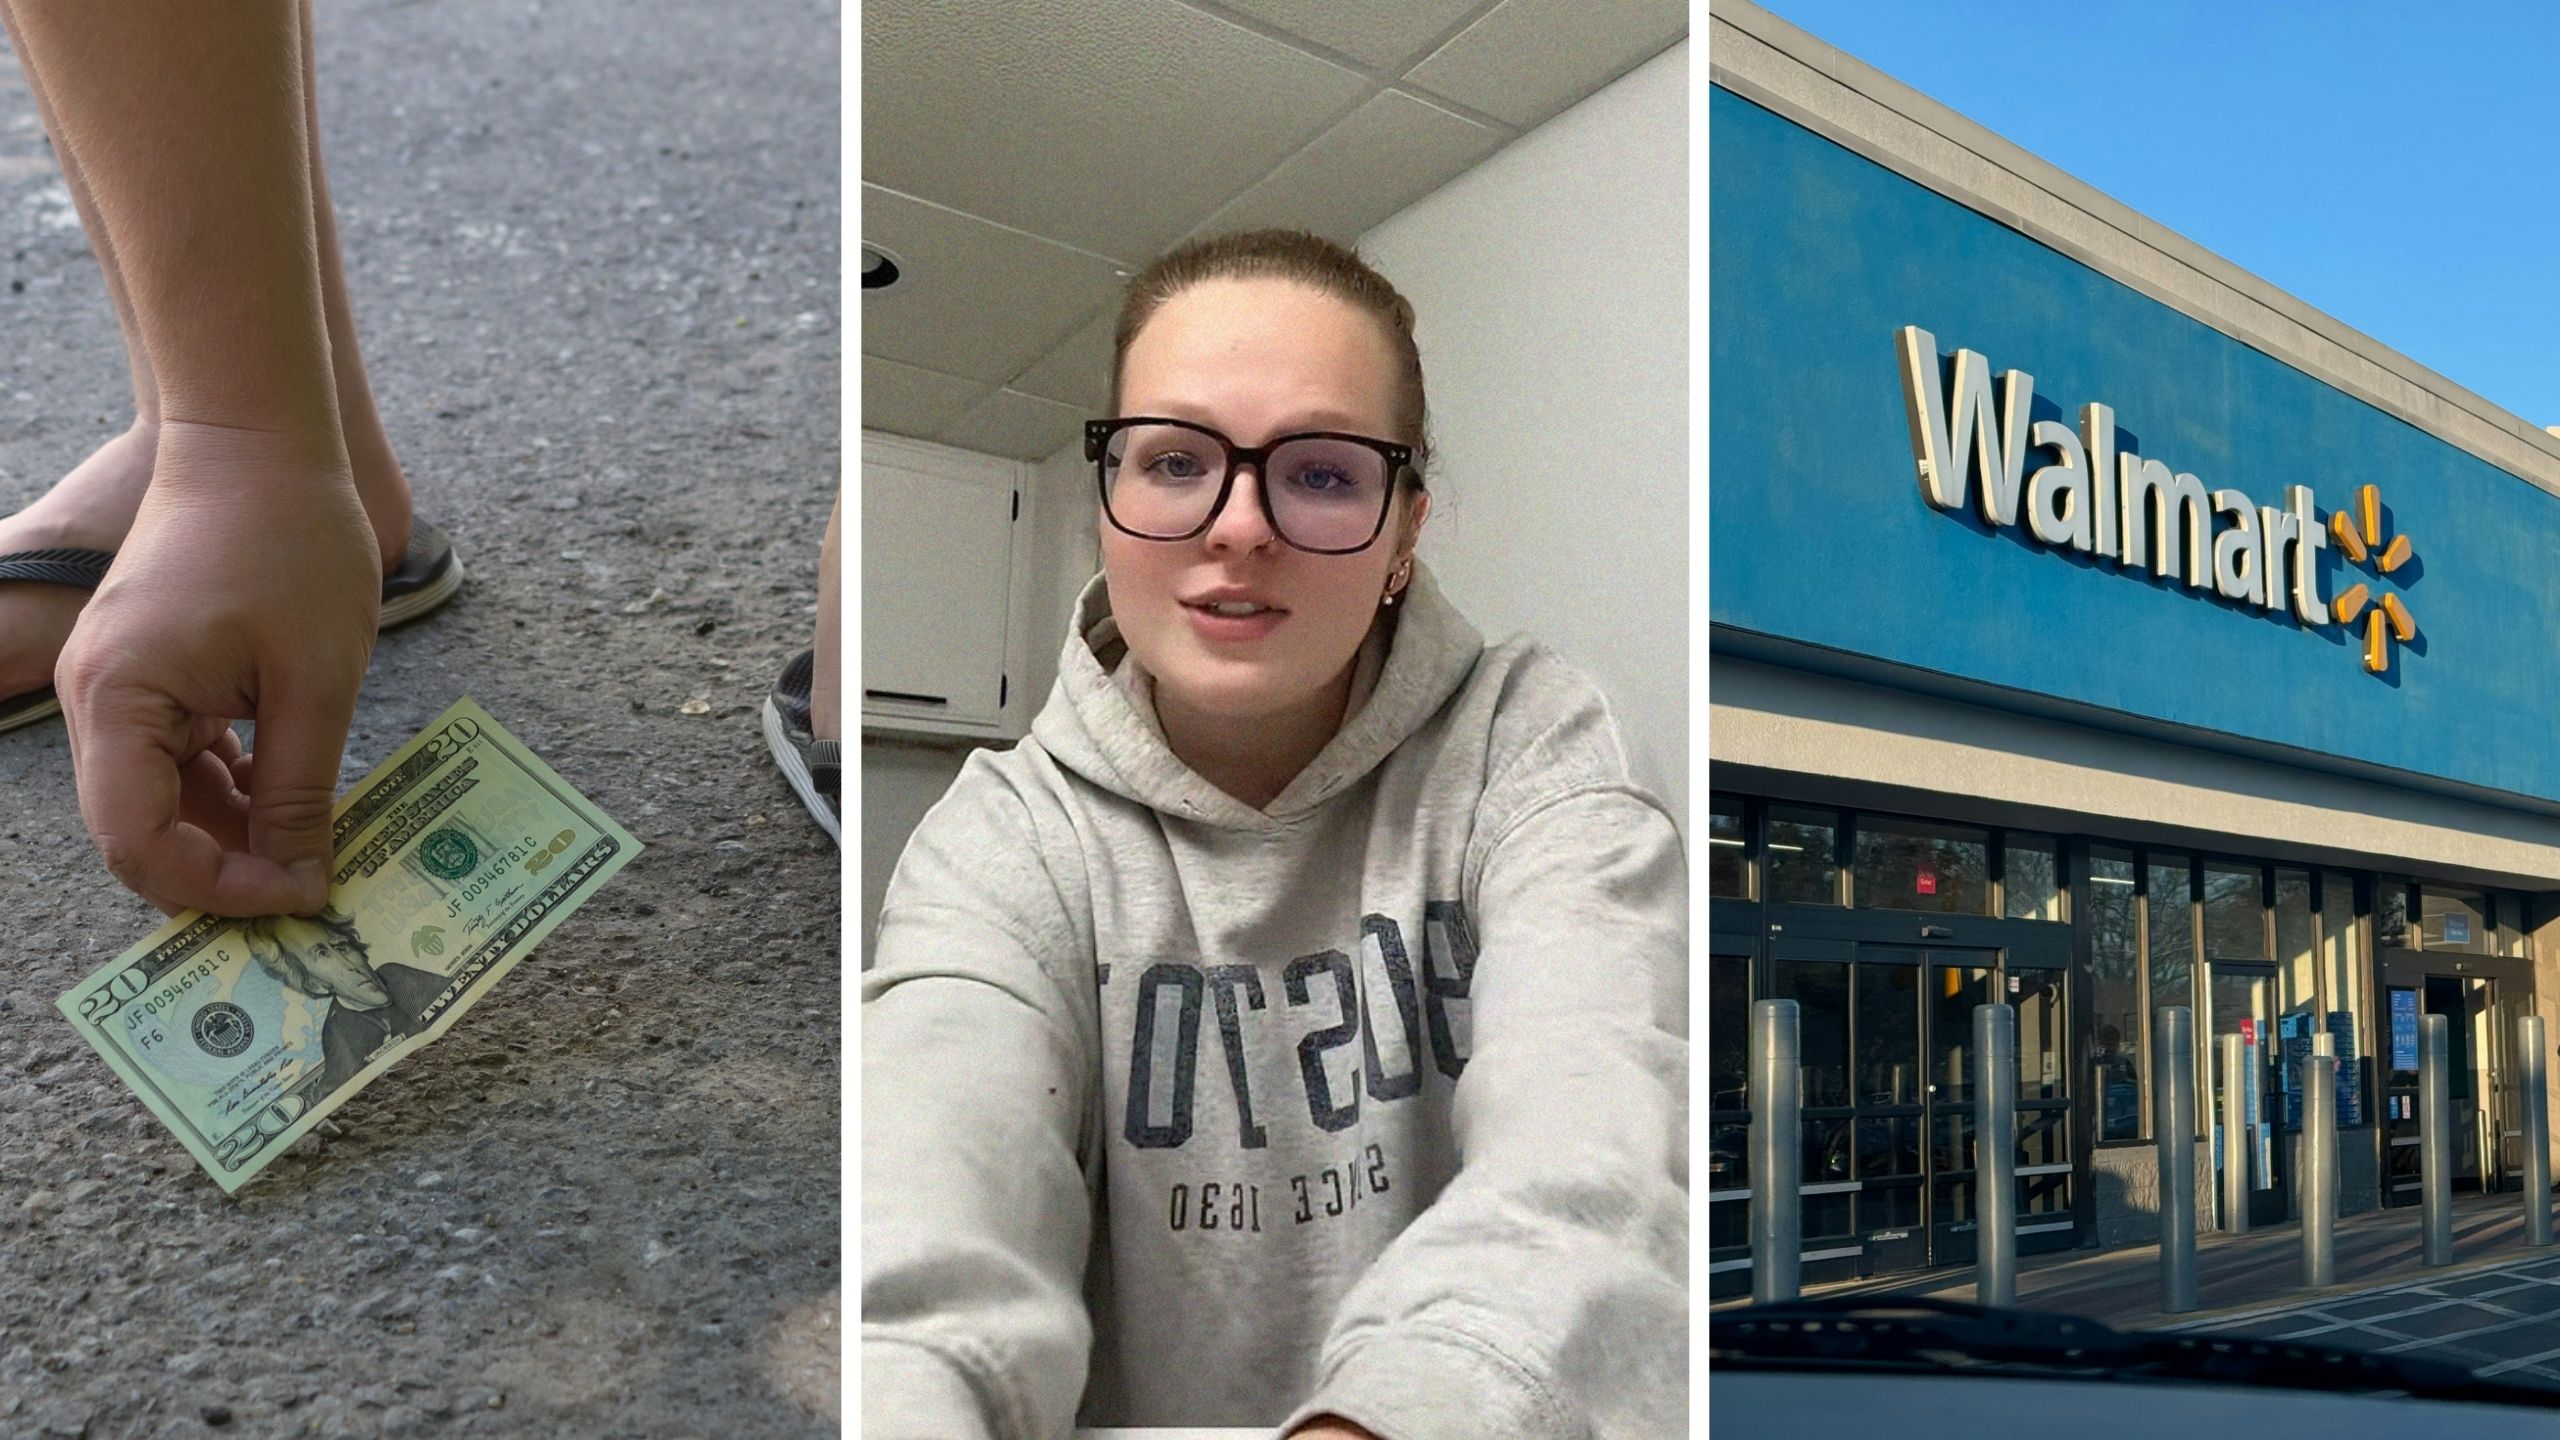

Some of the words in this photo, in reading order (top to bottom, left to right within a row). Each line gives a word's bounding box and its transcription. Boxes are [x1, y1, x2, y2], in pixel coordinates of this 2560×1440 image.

[1895, 325, 2329, 625] Walmart
[429, 718, 478, 760] 20
[334, 814, 408, 885] UNITED
[405, 755, 479, 819] STATES
[361, 848, 391, 878] OF
[392, 777, 480, 854] AMERICA
[386, 801, 408, 821] THE
[156, 915, 220, 962] FEDERA
[370, 772, 407, 803] NOTE
[523, 829, 575, 876] 20
[418, 931, 515, 1024] TWENTY
[510, 843, 612, 937] DOLLARS
[80, 968, 147, 1024] 20
[140, 1028, 164, 1050] F6
[215, 1095, 304, 1171] 20
